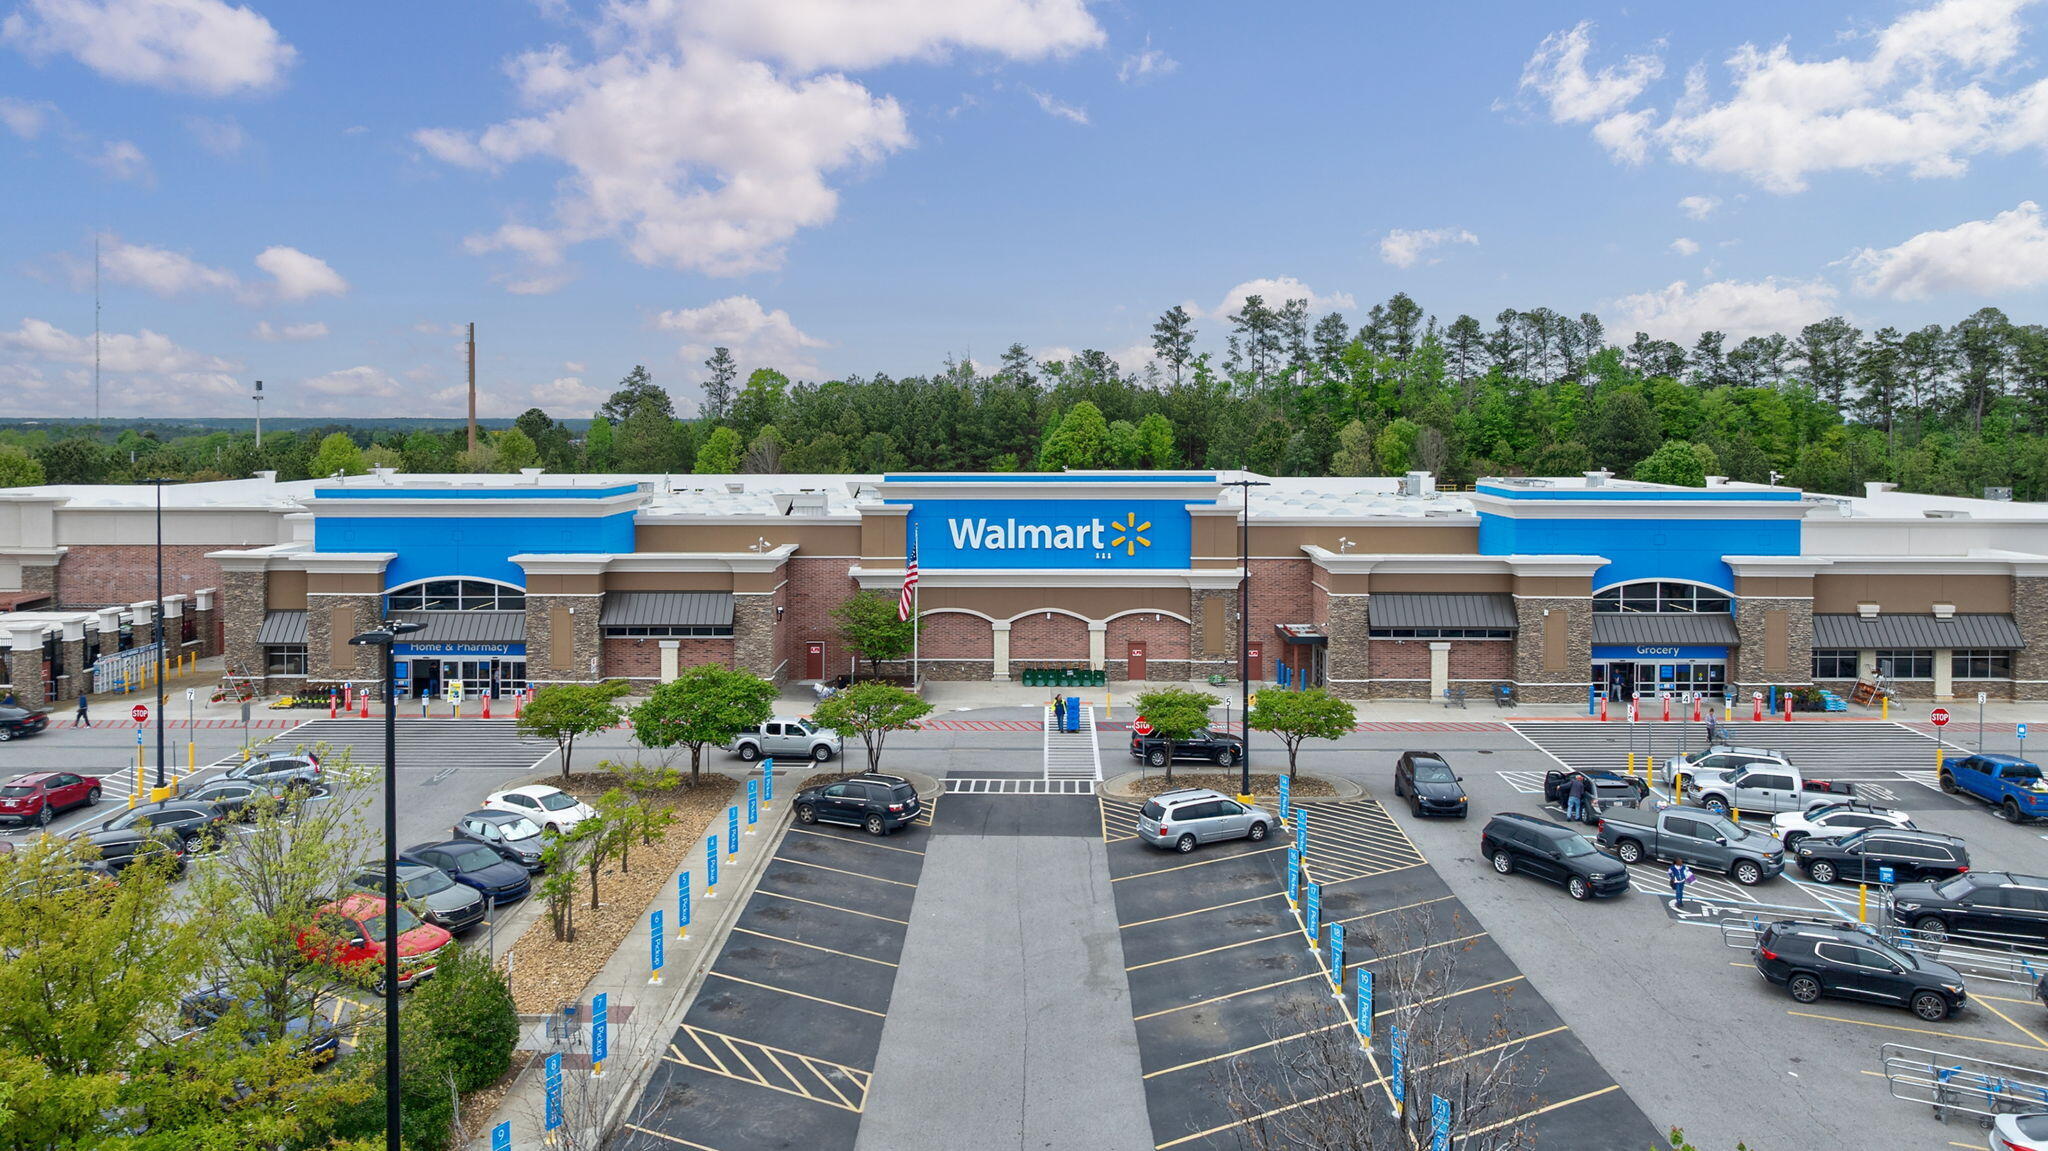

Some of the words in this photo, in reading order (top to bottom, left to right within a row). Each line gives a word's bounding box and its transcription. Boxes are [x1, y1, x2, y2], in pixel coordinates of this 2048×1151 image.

[948, 518, 1105, 549] Walmart
[410, 642, 441, 651] Home
[444, 642, 453, 651] &
[457, 642, 509, 654] Pharmacy
[1636, 645, 1680, 657] Grocery
[188, 691, 193, 700] 7
[1226, 697, 1231, 706] 5
[1979, 695, 1985, 704] 3
[132, 709, 148, 718] STOP
[1930, 712, 1949, 721] STOP
[1289, 873, 1297, 897] Pickup
[1333, 927, 1341, 938] 18
[1333, 952, 1341, 980] Pickup
[1360, 973, 1369, 985] 19
[597, 998, 603, 1008] 7
[1360, 1001, 1370, 1031] Pickup
[595, 1026, 604, 1057] Pickup
[551, 1059, 557, 1071] 8
[498, 1129, 505, 1141] 9
